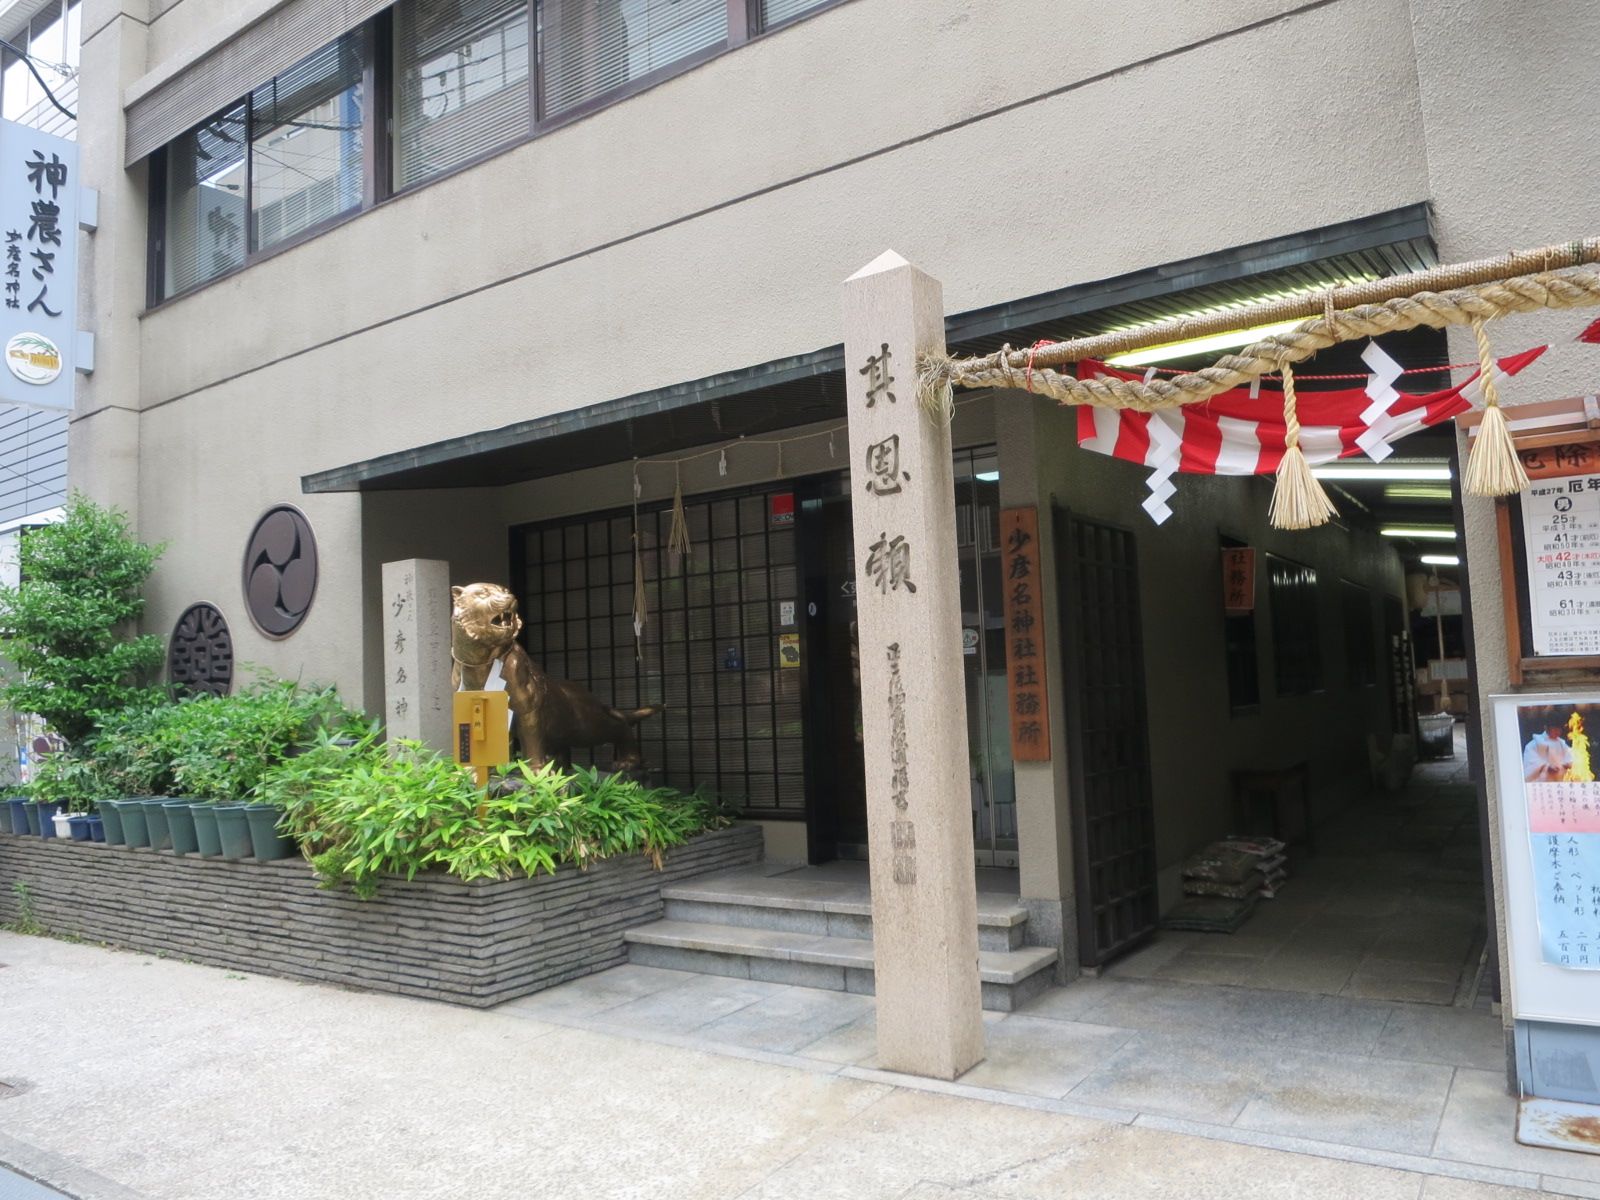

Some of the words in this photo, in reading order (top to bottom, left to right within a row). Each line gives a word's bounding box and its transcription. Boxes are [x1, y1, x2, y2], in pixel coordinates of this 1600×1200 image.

[25, 149, 68, 317] 神農さん
[1568, 477, 1600, 494] 厄年
[1007, 527, 1042, 747] 少彦名神社社務所
